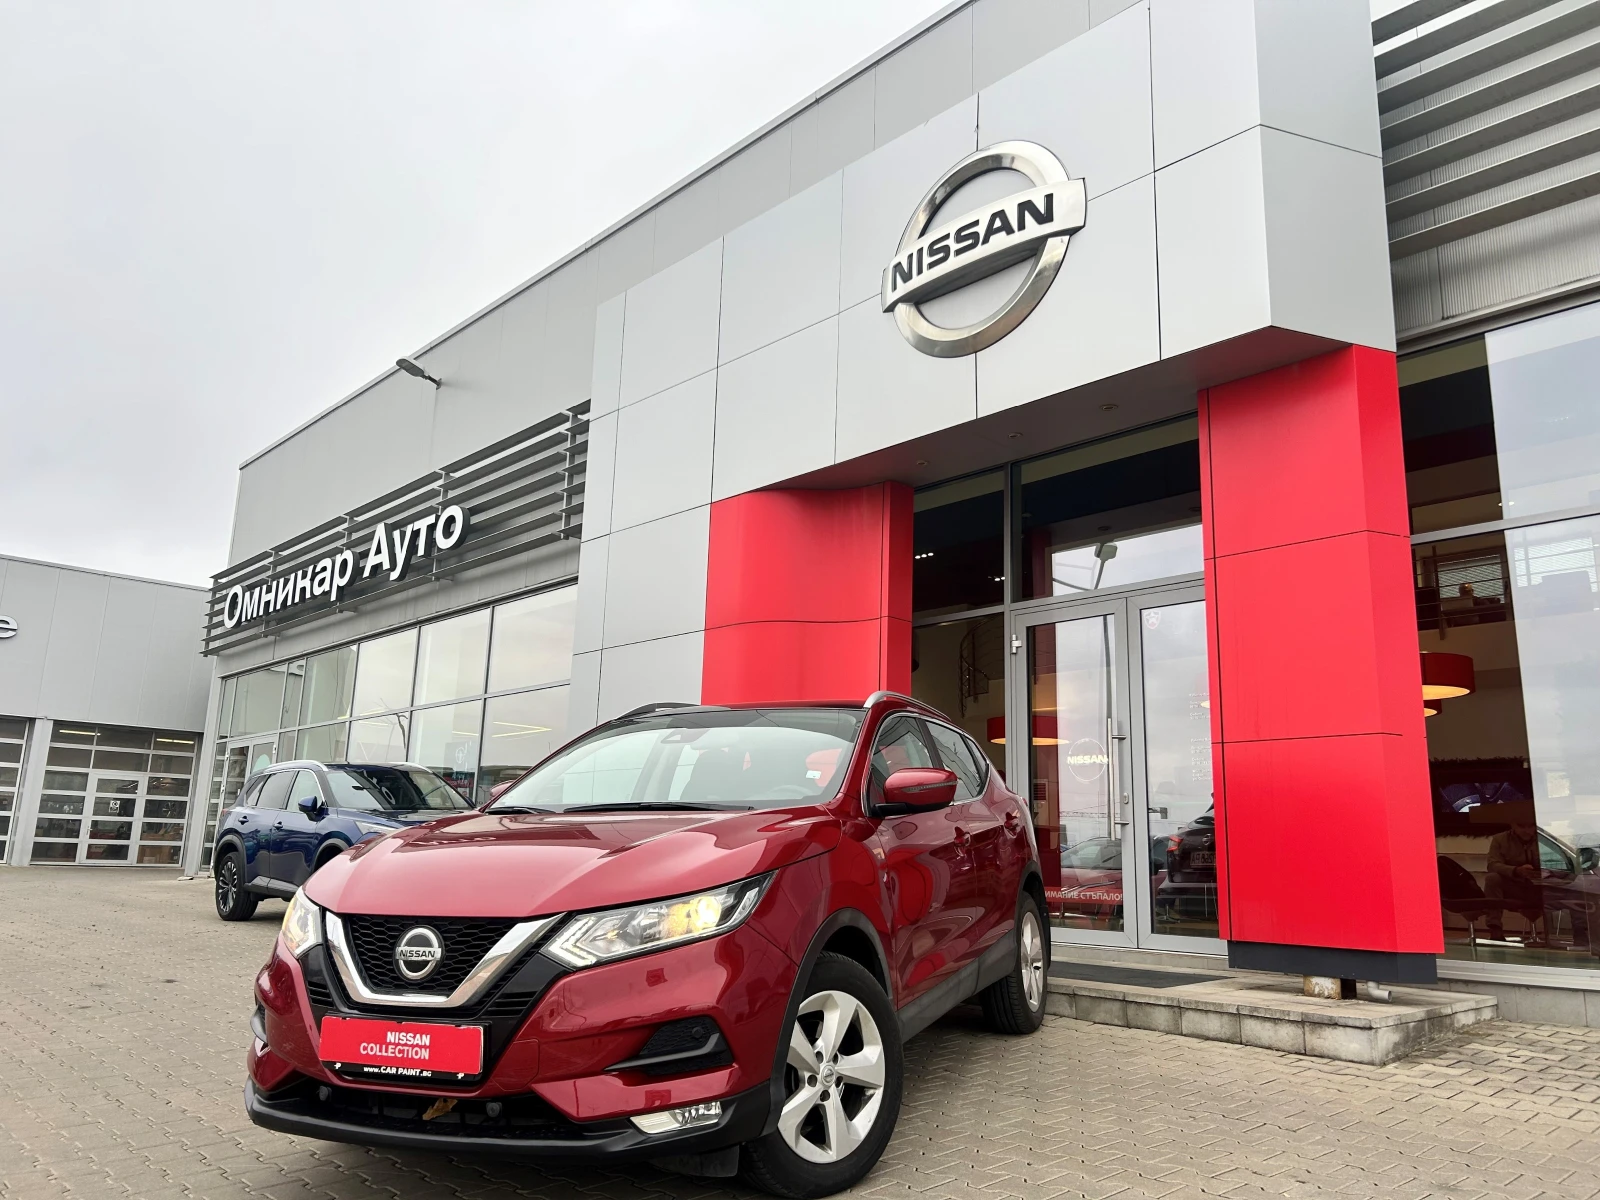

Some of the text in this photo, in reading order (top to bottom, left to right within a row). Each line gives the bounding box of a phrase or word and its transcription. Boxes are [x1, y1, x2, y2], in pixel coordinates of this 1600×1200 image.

[891, 193, 1054, 292] NISSAN
[223, 504, 464, 629] Омникар Ауто
[1067, 755, 1108, 765] NISSAN
[400, 949, 436, 958] NISSAN
[386, 1031, 430, 1046] NISSAN
[360, 1042, 430, 1060] COLLECTION
